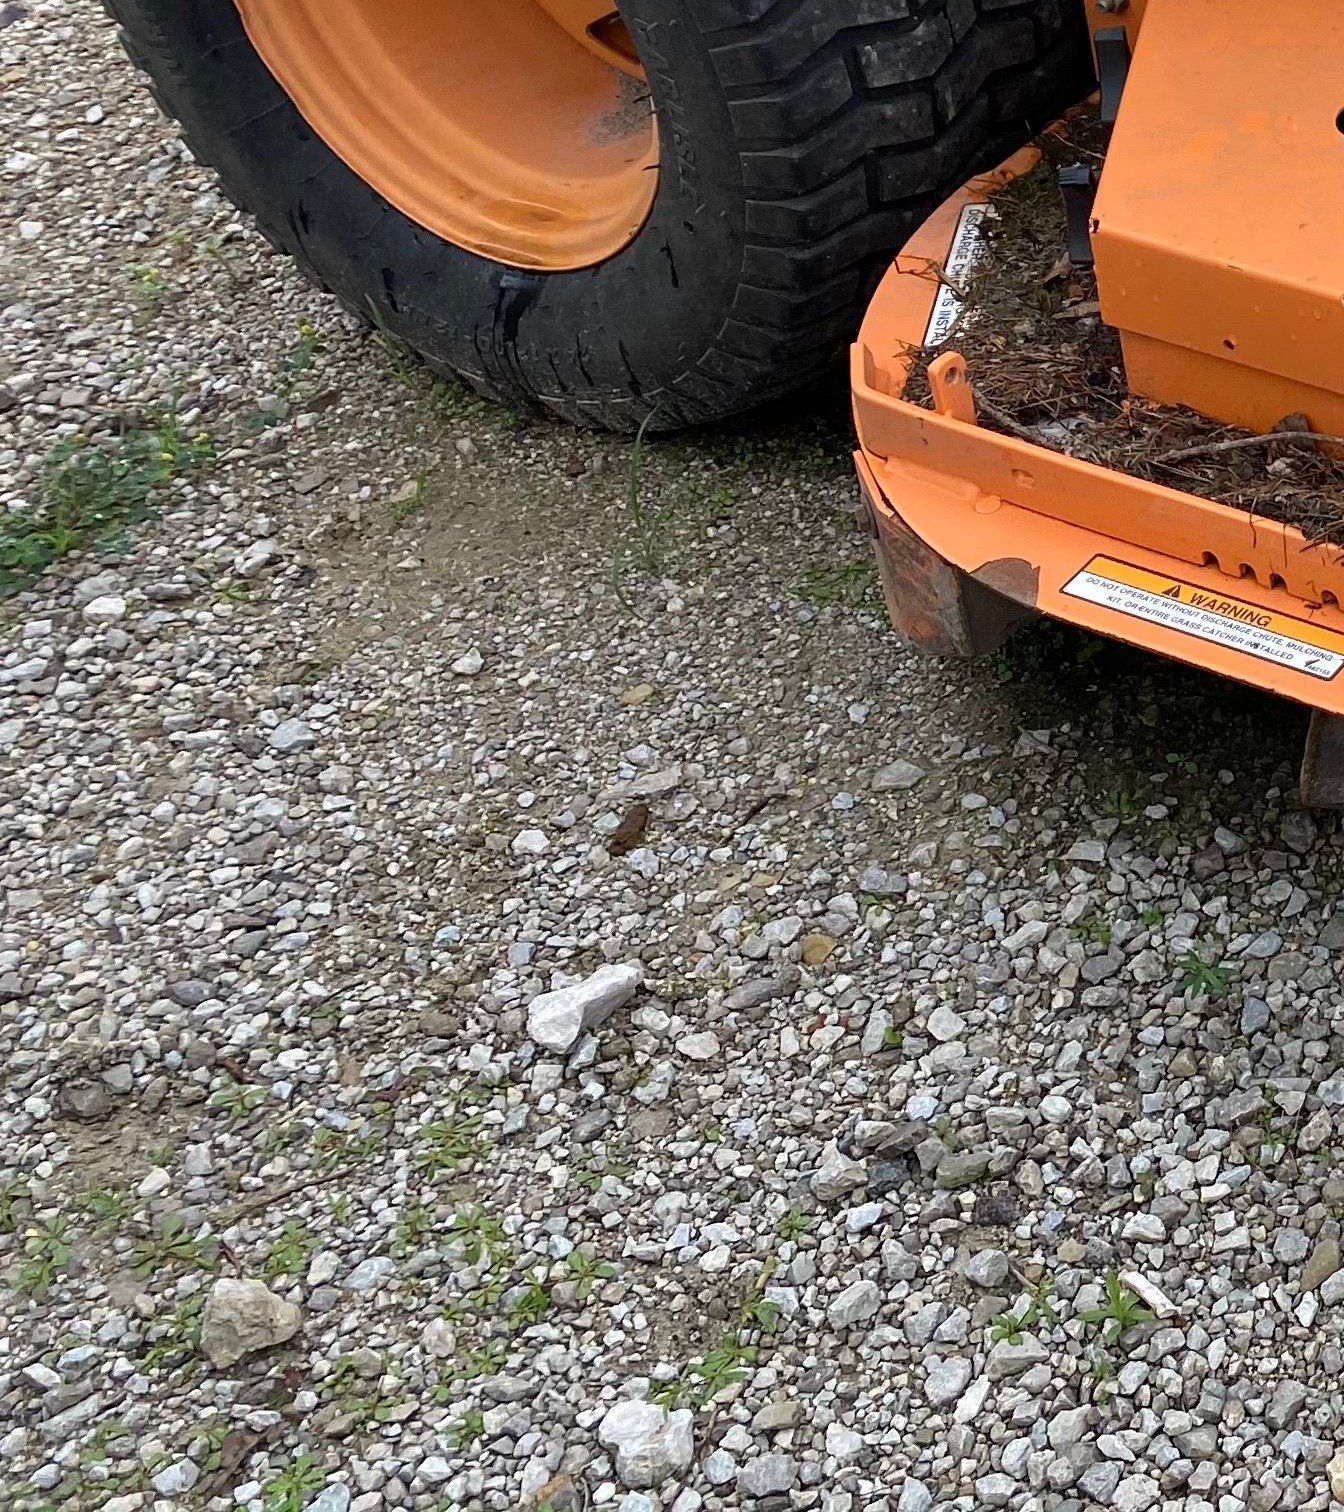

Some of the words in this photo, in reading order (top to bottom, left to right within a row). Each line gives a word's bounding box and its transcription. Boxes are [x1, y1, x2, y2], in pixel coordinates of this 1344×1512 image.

[954, 208, 982, 262] DISCHARGE
[941, 298, 954, 308] IS
[930, 310, 953, 346] INSTAL
[1085, 576, 1101, 586] DO
[1100, 581, 1121, 592] NOT
[1119, 587, 1162, 606] OPERATE
[1161, 600, 1202, 618] WITHOUT
[1200, 611, 1255, 636] DISCHARGE
[1285, 641, 1334, 662] MULCHING
[1123, 600, 1139, 610] OR
[1138, 605, 1170, 621] ENTIRE
[1170, 615, 1203, 631] GRASS
[1202, 626, 1246, 645] CATCHER
[1244, 640, 1294, 660] INSTALLED
[1189, 591, 1273, 628] WARNING
